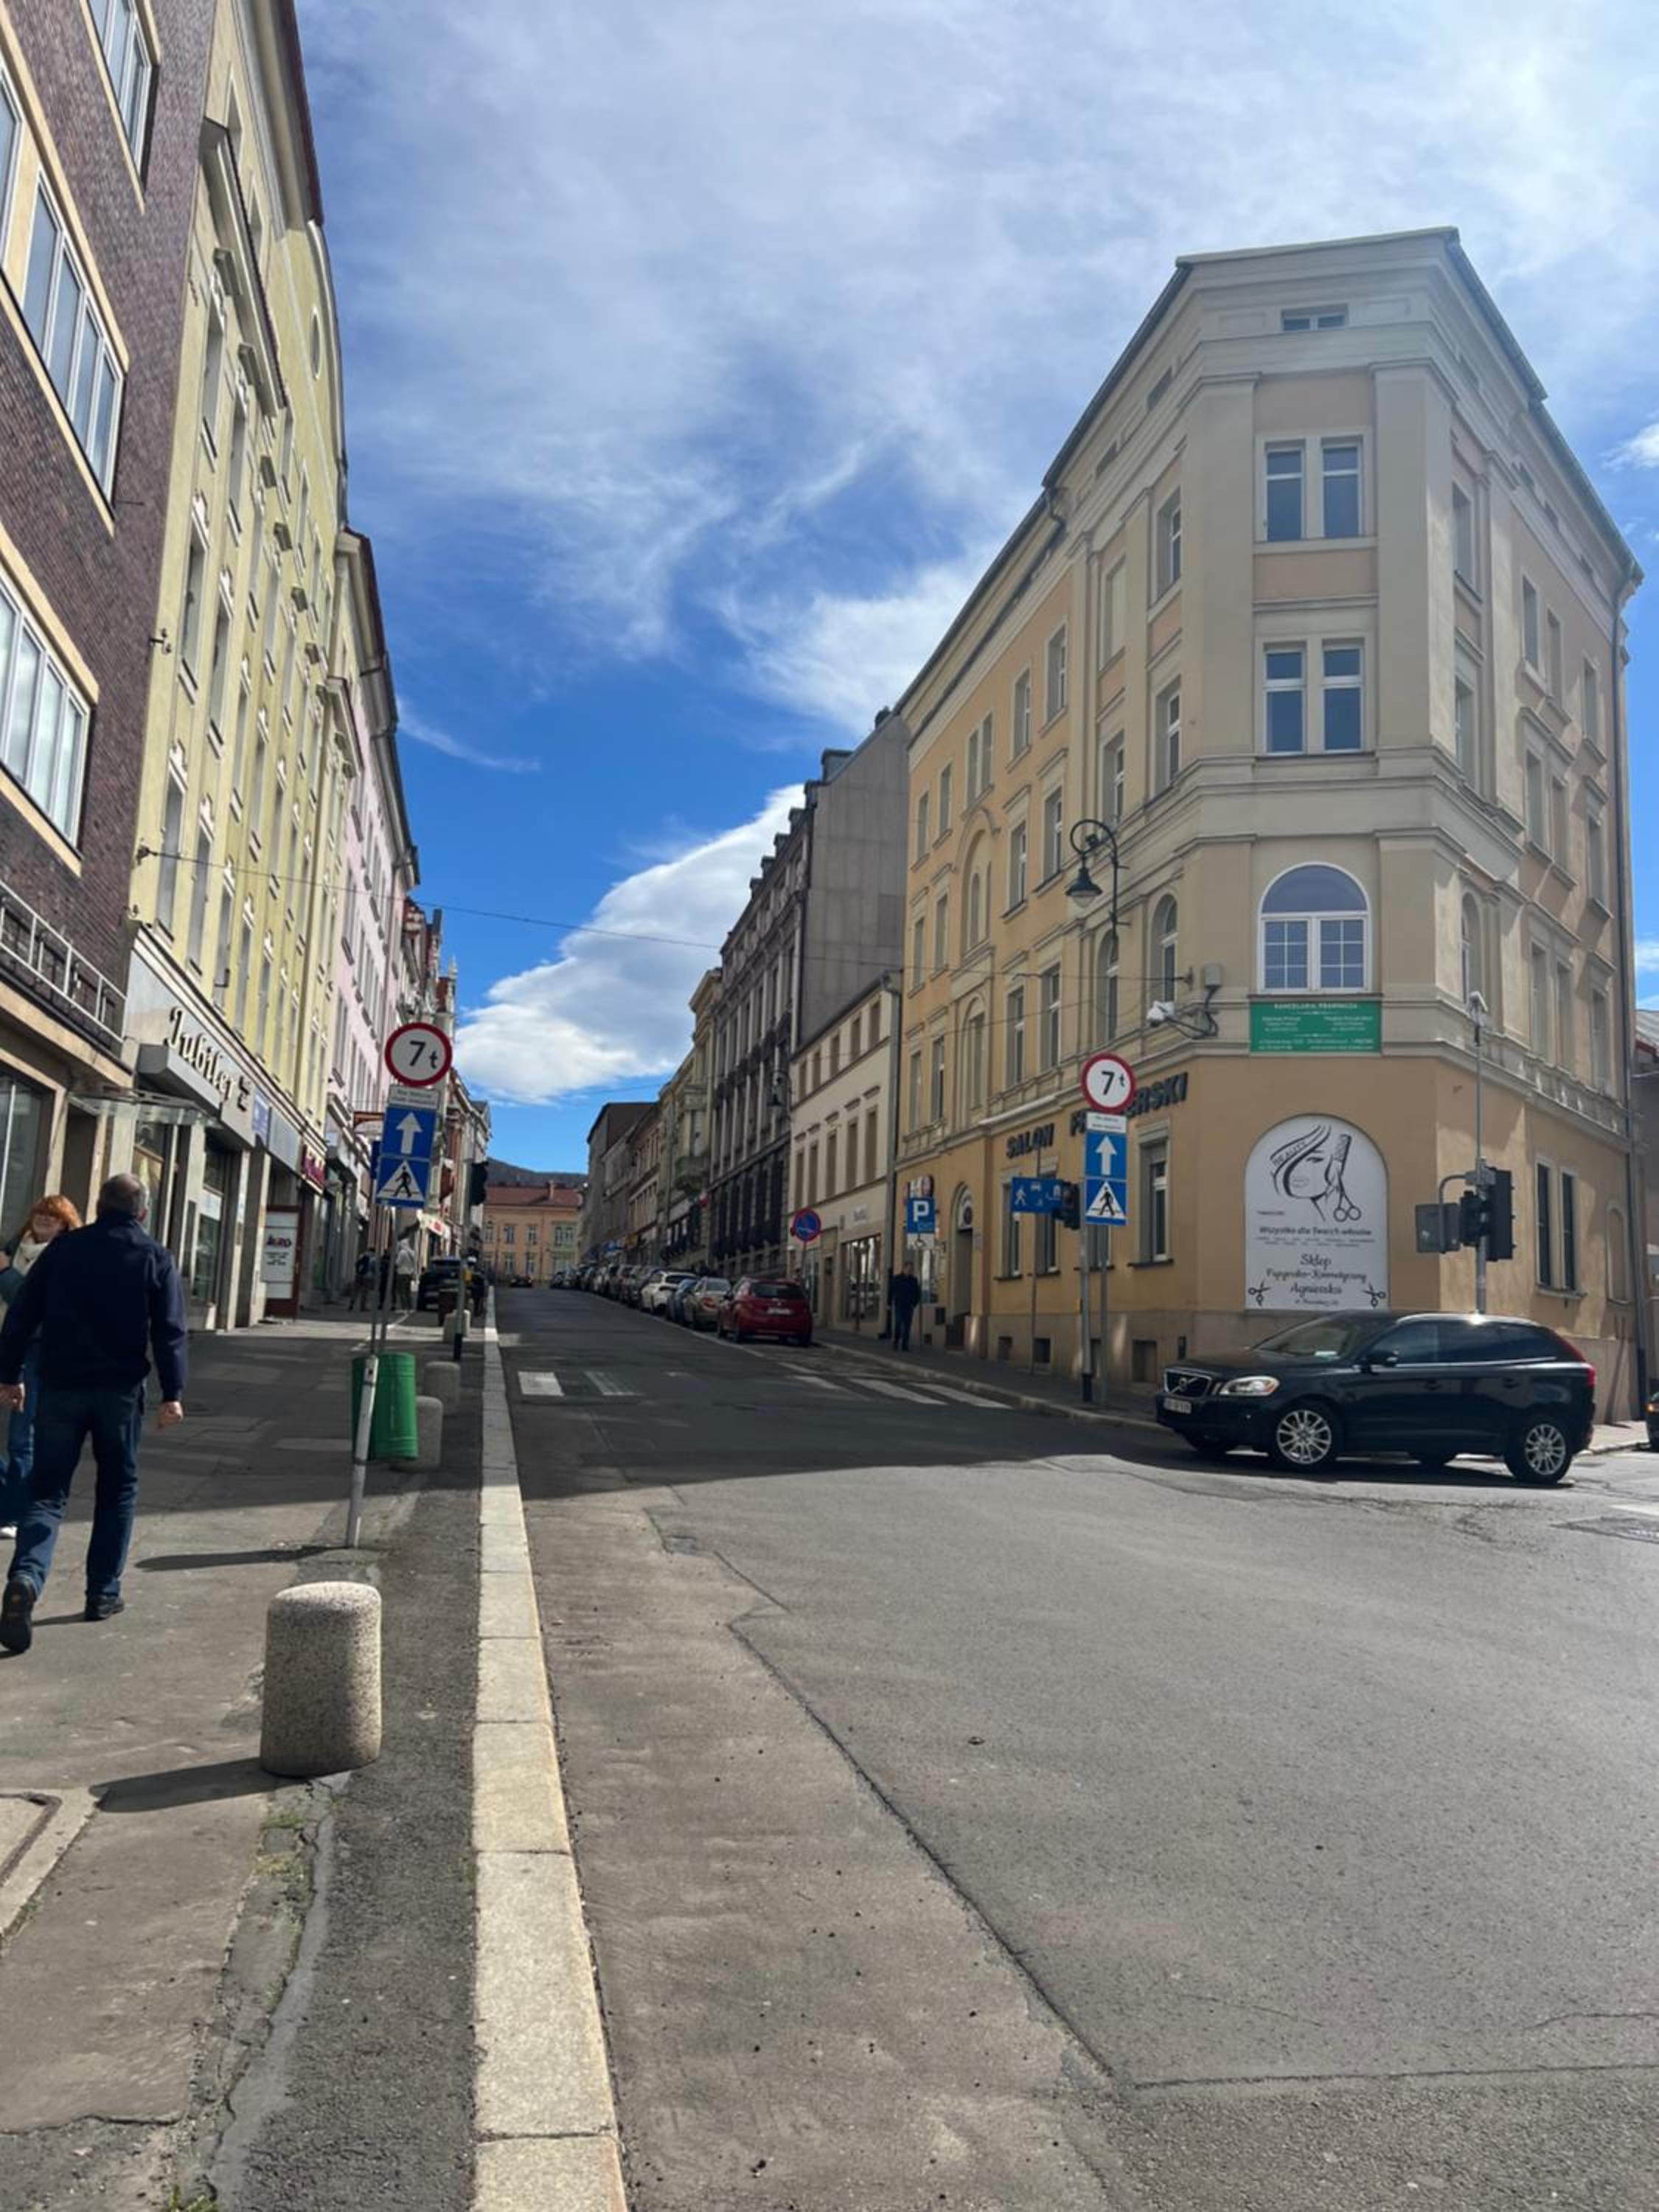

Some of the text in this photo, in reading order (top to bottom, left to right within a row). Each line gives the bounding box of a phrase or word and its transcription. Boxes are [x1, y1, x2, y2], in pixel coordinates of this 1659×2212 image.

[164, 1007, 234, 1101] Jubiler
[1006, 1123, 1055, 1158] SALON
[913, 1200, 930, 1222] P
[1299, 1253, 1332, 1271] Sklep
